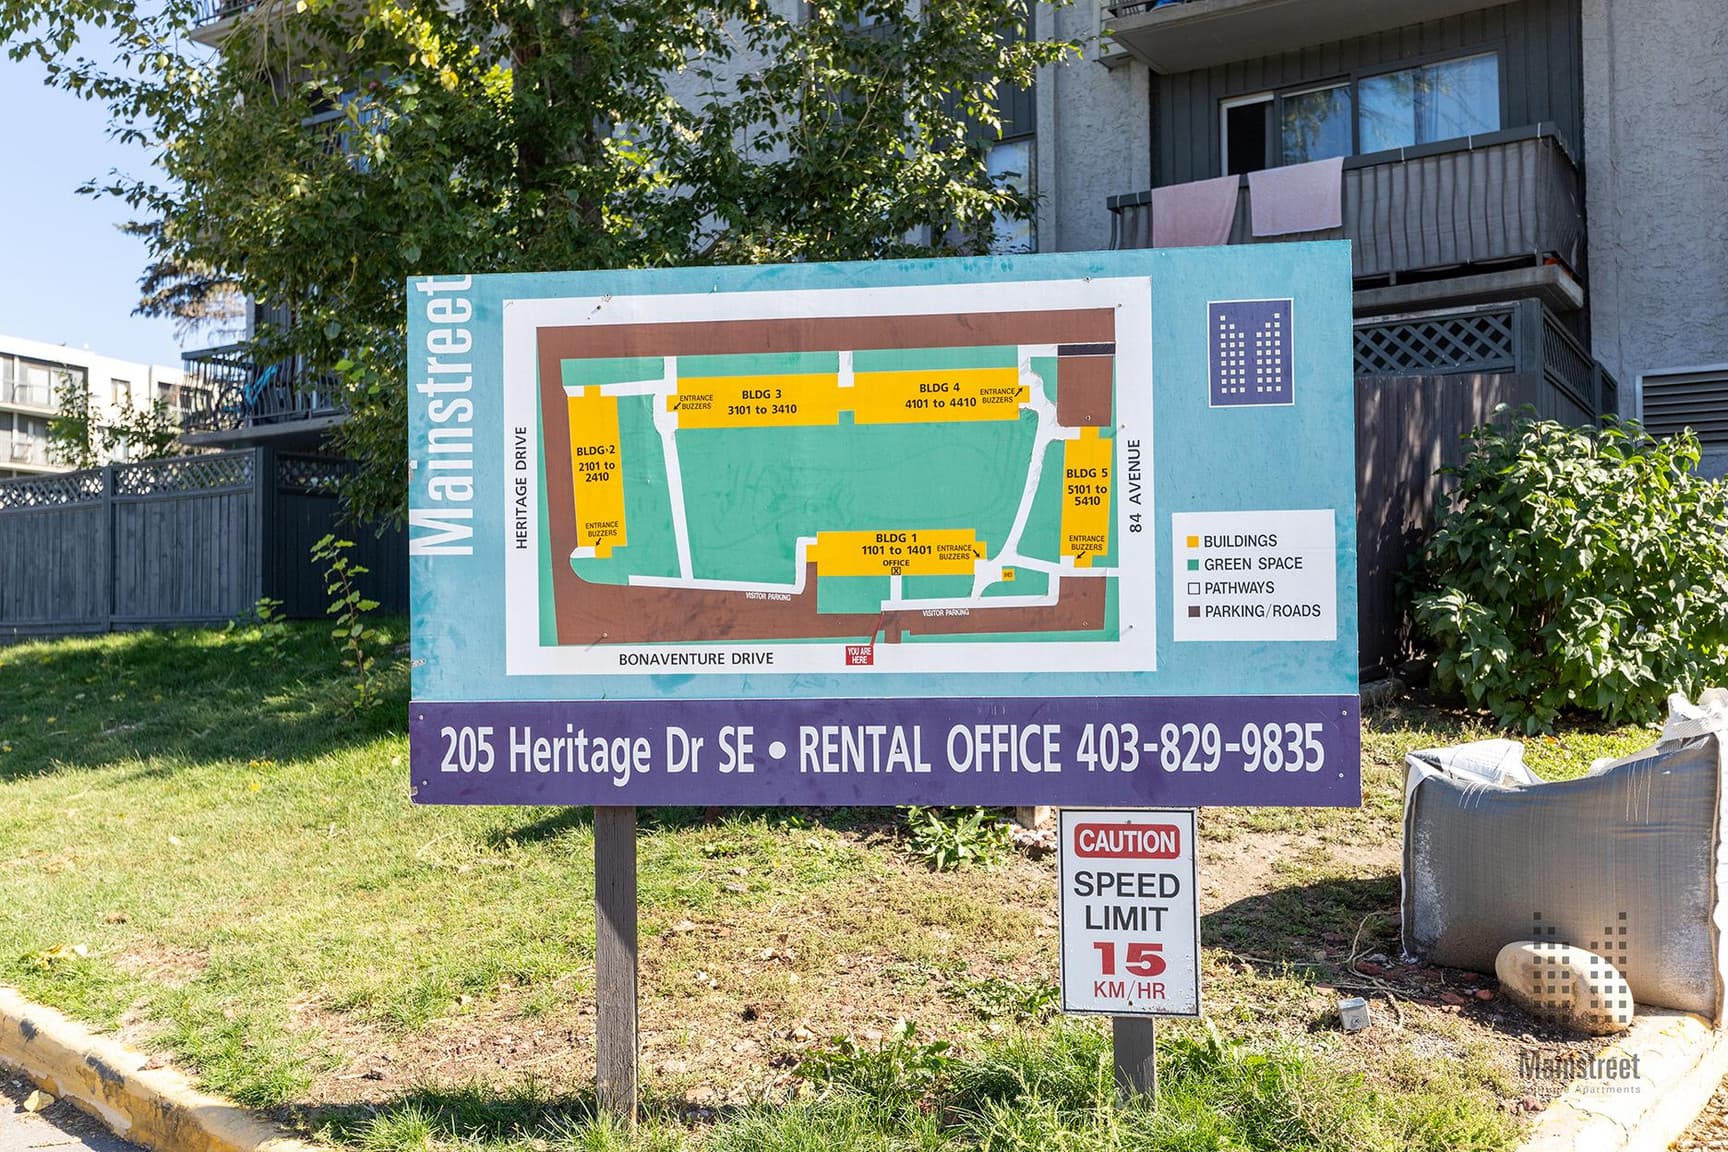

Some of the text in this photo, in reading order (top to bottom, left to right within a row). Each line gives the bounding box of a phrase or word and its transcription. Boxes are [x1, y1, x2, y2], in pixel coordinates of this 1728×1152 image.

[919, 382, 960, 393] BLDG 4
[979, 387, 1015, 397] ENTRANCE
[679, 394, 714, 402] ENTRANCE
[741, 389, 782, 400] BLDG 3
[982, 396, 1014, 404] BUZZERS
[681, 402, 712, 411] BUZZERS
[905, 396, 977, 409] 4101 to 4410
[727, 403, 797, 416] 3101 to 3410
[408, 275, 473, 556] Mainstreet
[578, 460, 615, 472] 2101 to
[585, 472, 609, 482] 2410
[1066, 468, 1108, 478] BLDG 5
[515, 426, 528, 550] HERITAGE DRIVE
[1067, 484, 1107, 495] 5101 to
[1128, 439, 1142, 533] 84 AVENUE
[1074, 496, 1101, 506] 5410
[585, 521, 619, 530] ENTRANCE
[587, 529, 617, 538] BUZZERS
[876, 533, 917, 543] BLDG 1
[1069, 535, 1105, 543] ENTRANCE
[1204, 535, 1278, 548] BUILDINGS
[862, 545, 932, 555] 1101 to 1401
[1071, 543, 1103, 552] BUZZERS
[1204, 556, 1303, 571] GREEN SPACE
[1205, 581, 1275, 595] PATHWAYS
[745, 592, 791, 601] VISITOR PARKING
[922, 608, 970, 617] VISITOR PARKING
[1205, 604, 1321, 619] PARKING/ROADS
[847, 647, 872, 656] YOU ARE
[619, 652, 774, 666] BONAVENTURE DRIVE
[851, 655, 868, 664] HERE
[440, 721, 1326, 786] 205 Heritage Dr SE RENTAL OFFICE 403-829-9835
[1079, 829, 1176, 853] CAUTION
[1073, 870, 1180, 898] SPEED
[1085, 905, 1169, 931] LIMIT
[1093, 941, 1167, 977] 15
[1093, 980, 1166, 1000] KM/HR
